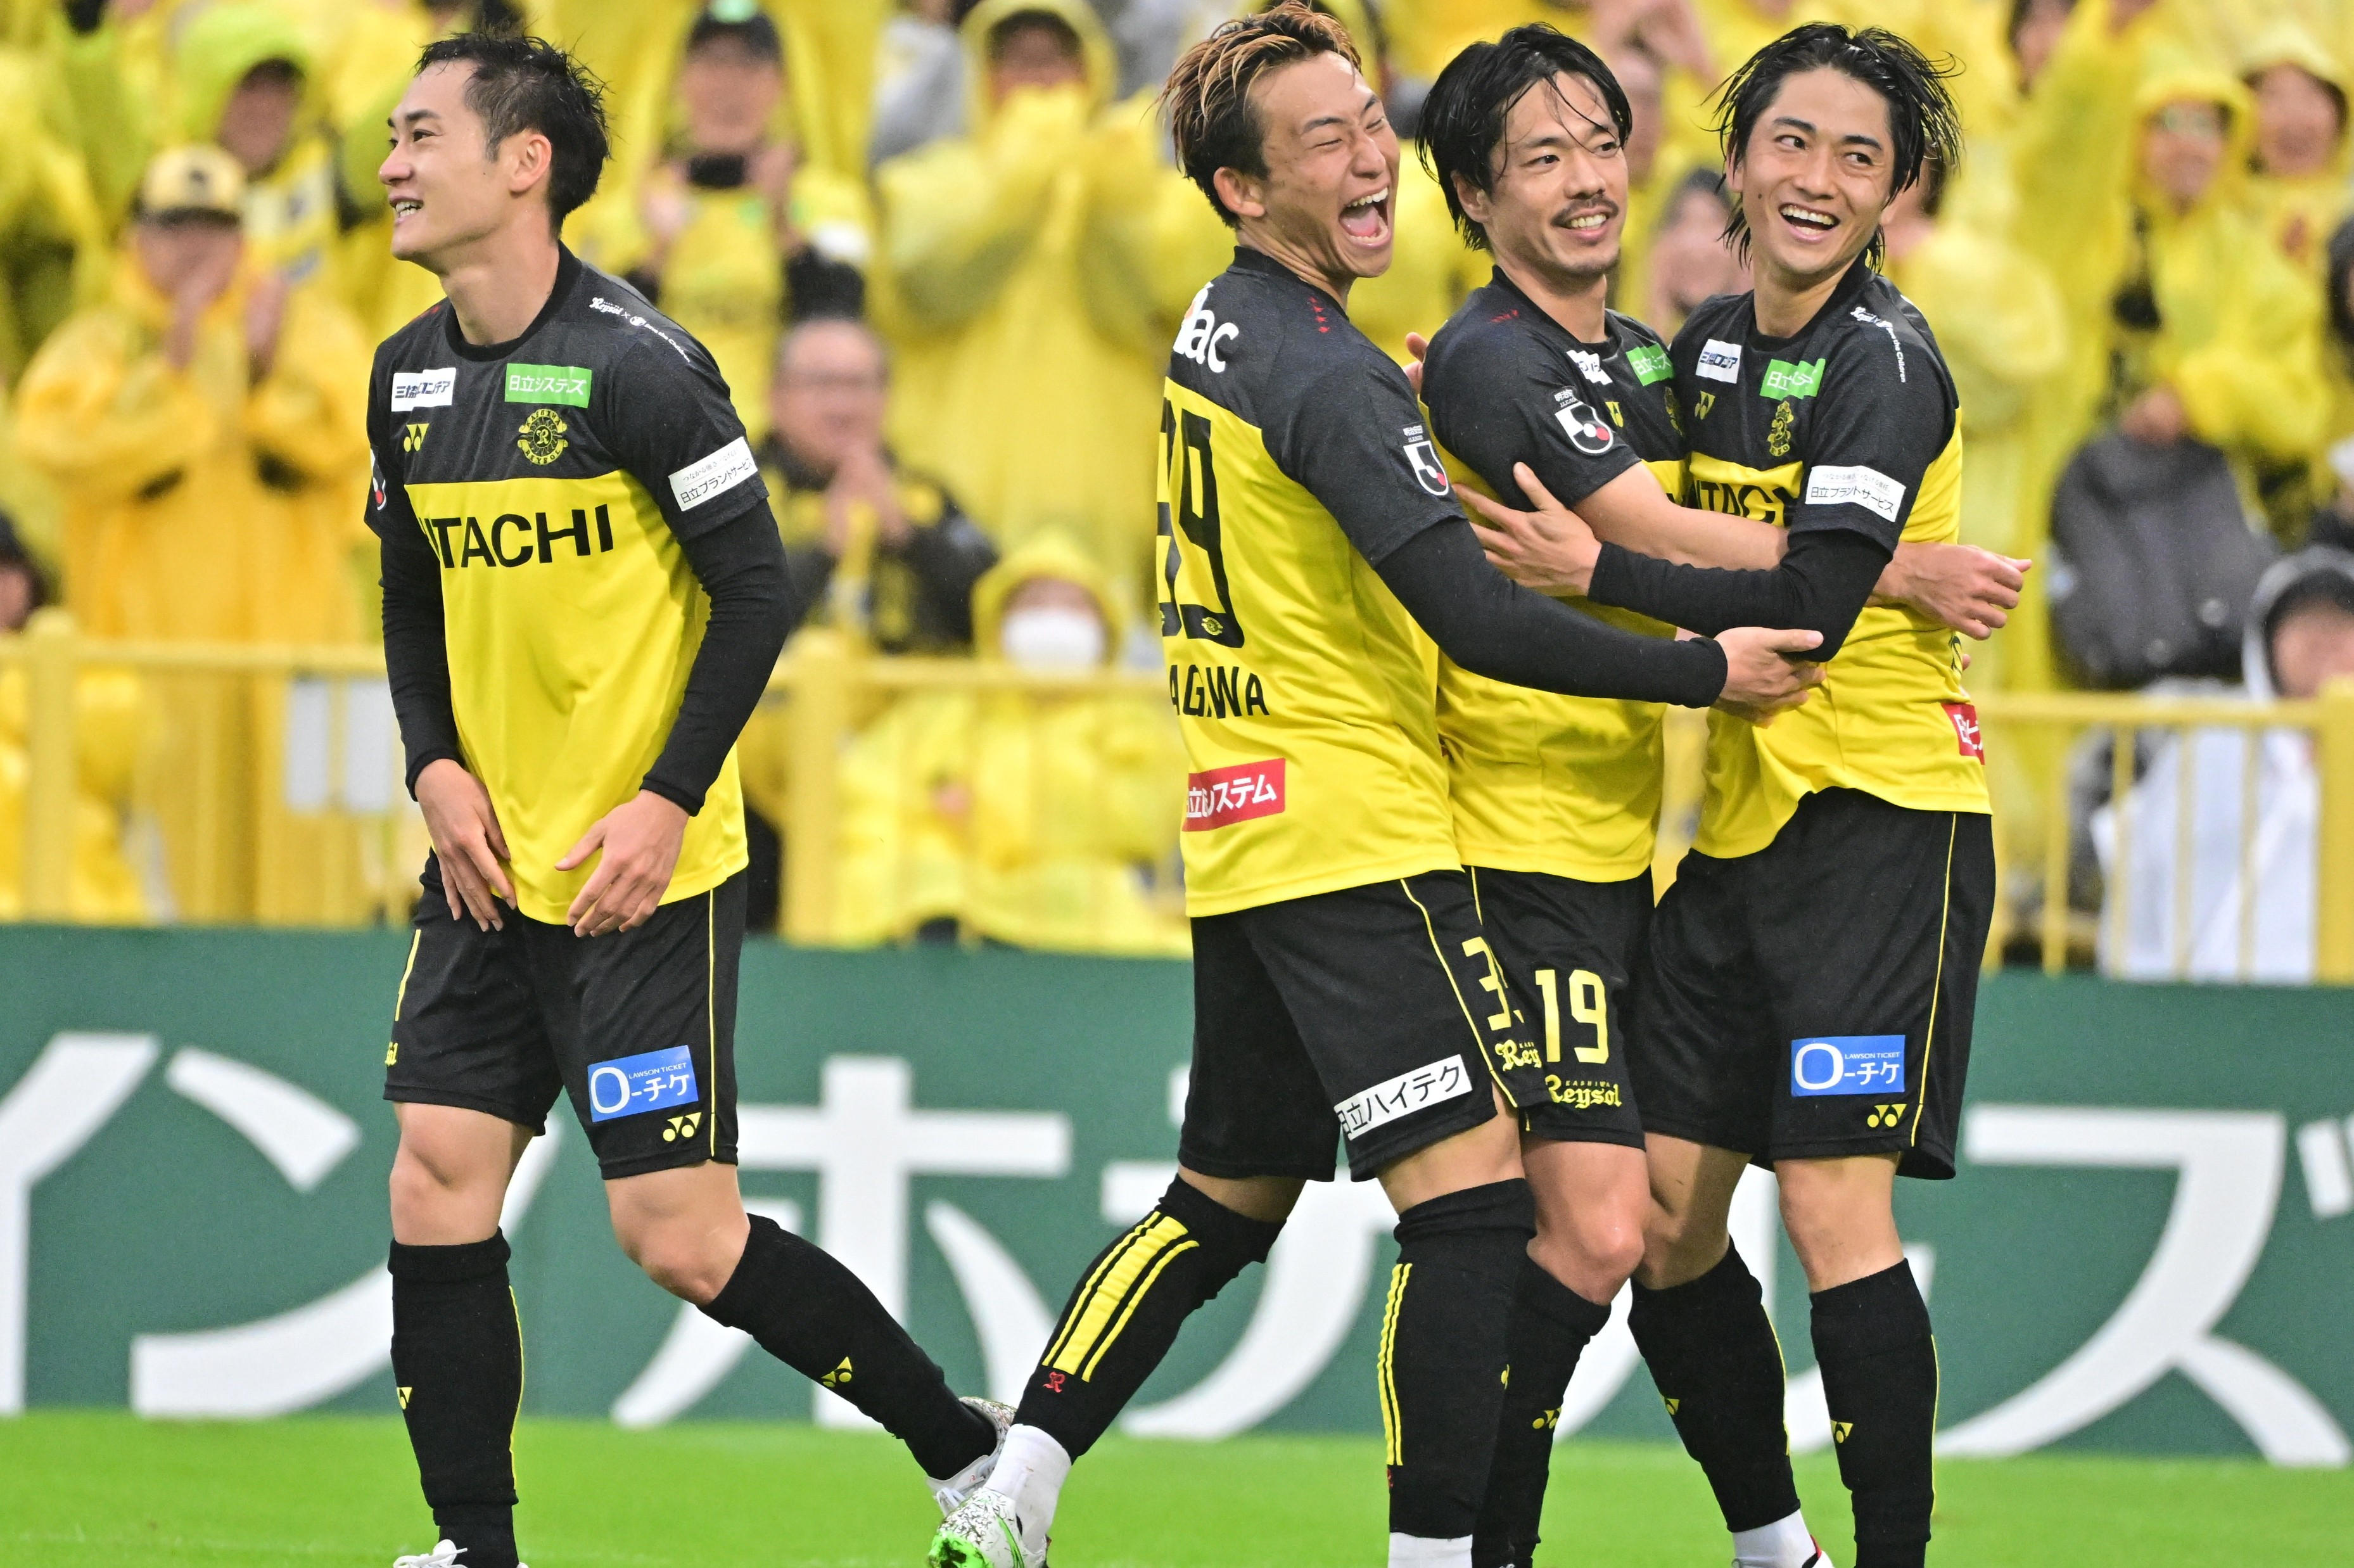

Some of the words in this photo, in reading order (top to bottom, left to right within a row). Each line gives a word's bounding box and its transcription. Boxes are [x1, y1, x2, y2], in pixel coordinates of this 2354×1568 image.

[1810, 485, 1893, 514] 日立プラントサービス
[419, 504, 613, 568] ITACHI
[1535, 969, 1610, 1064] 19
[629, 1069, 660, 1080] LAWSON
[661, 1062, 687, 1073] TICKET
[1544, 1074, 1622, 1109] Reysol
[1337, 1064, 1461, 1135] 日立ハイテク
